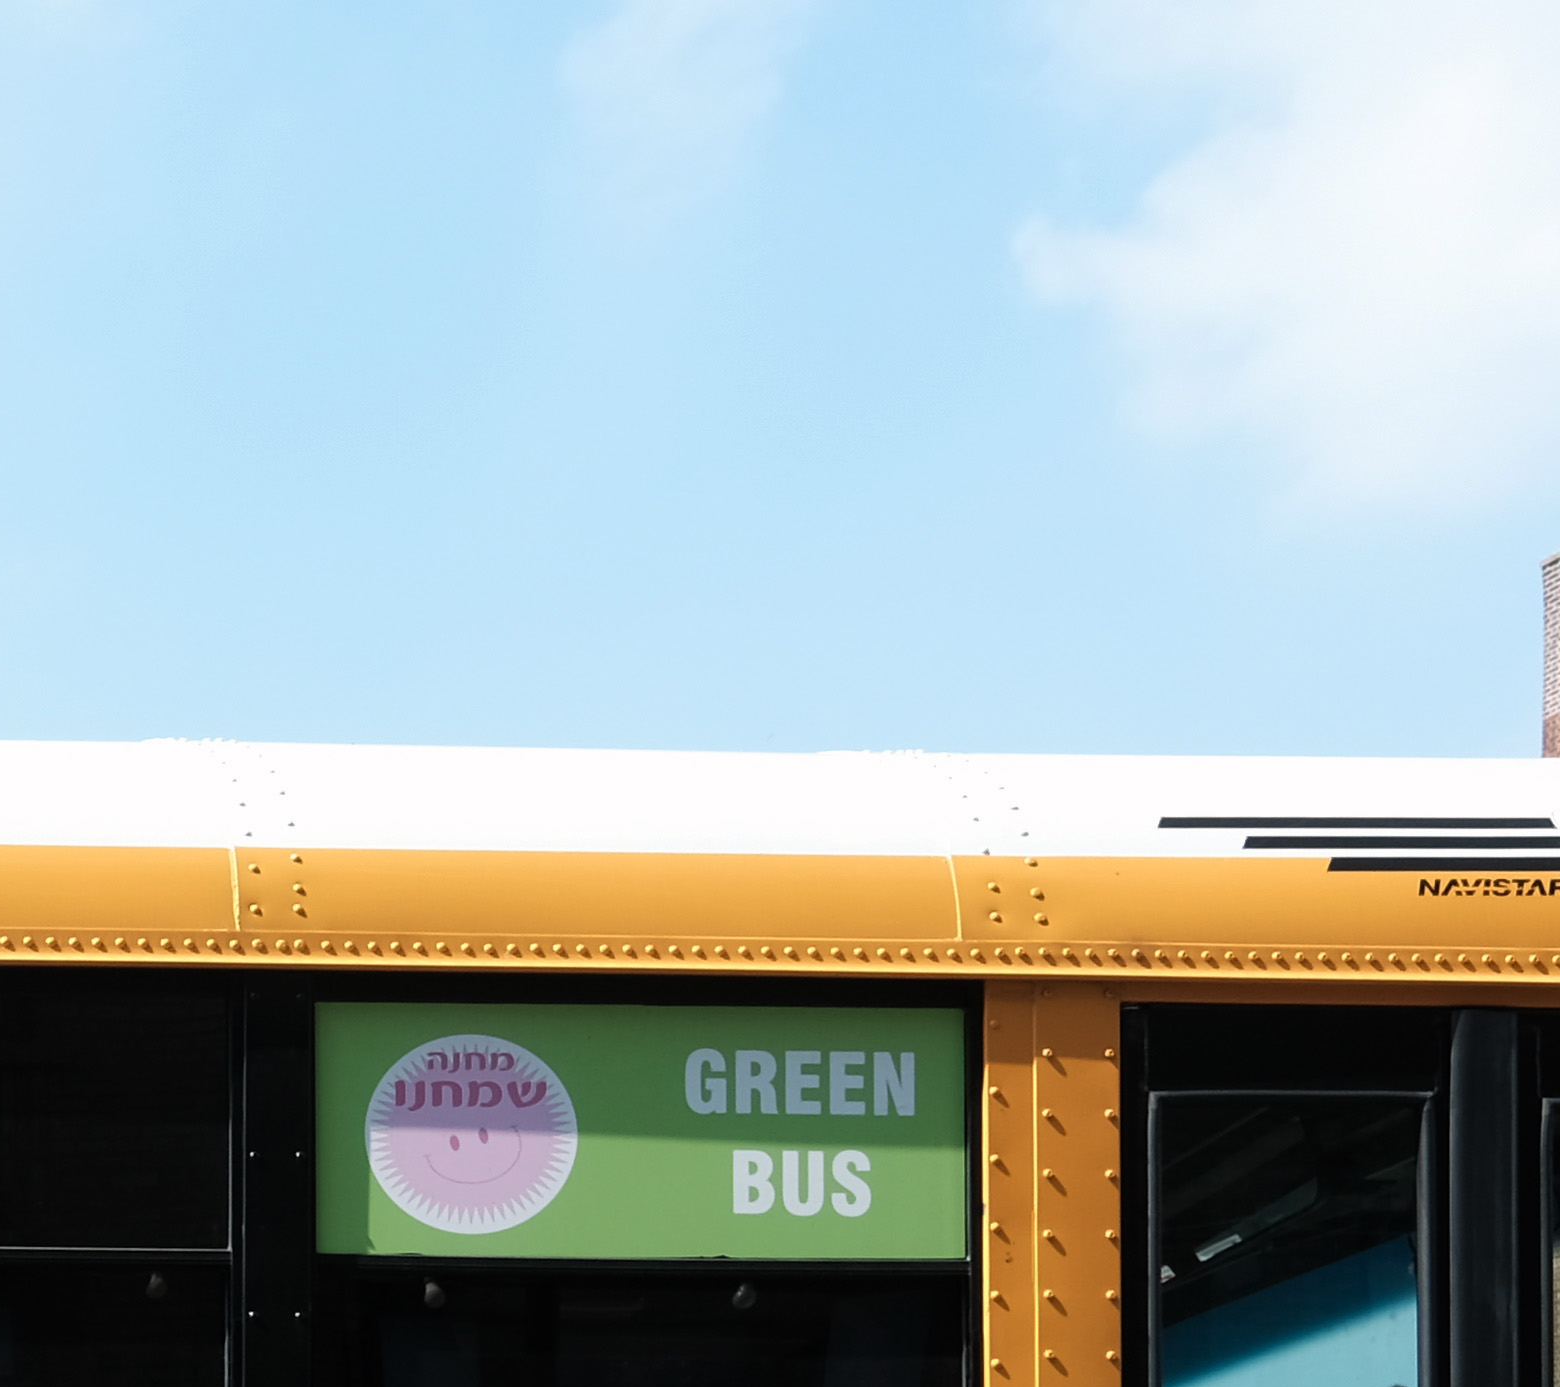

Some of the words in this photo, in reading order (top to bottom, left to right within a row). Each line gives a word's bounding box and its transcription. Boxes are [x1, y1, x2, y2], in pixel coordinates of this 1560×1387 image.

[427, 1052, 515, 1073] מחנה
[684, 1048, 916, 1117] GREEN
[394, 1080, 548, 1112] שמחנו
[732, 1149, 872, 1218] BUS
